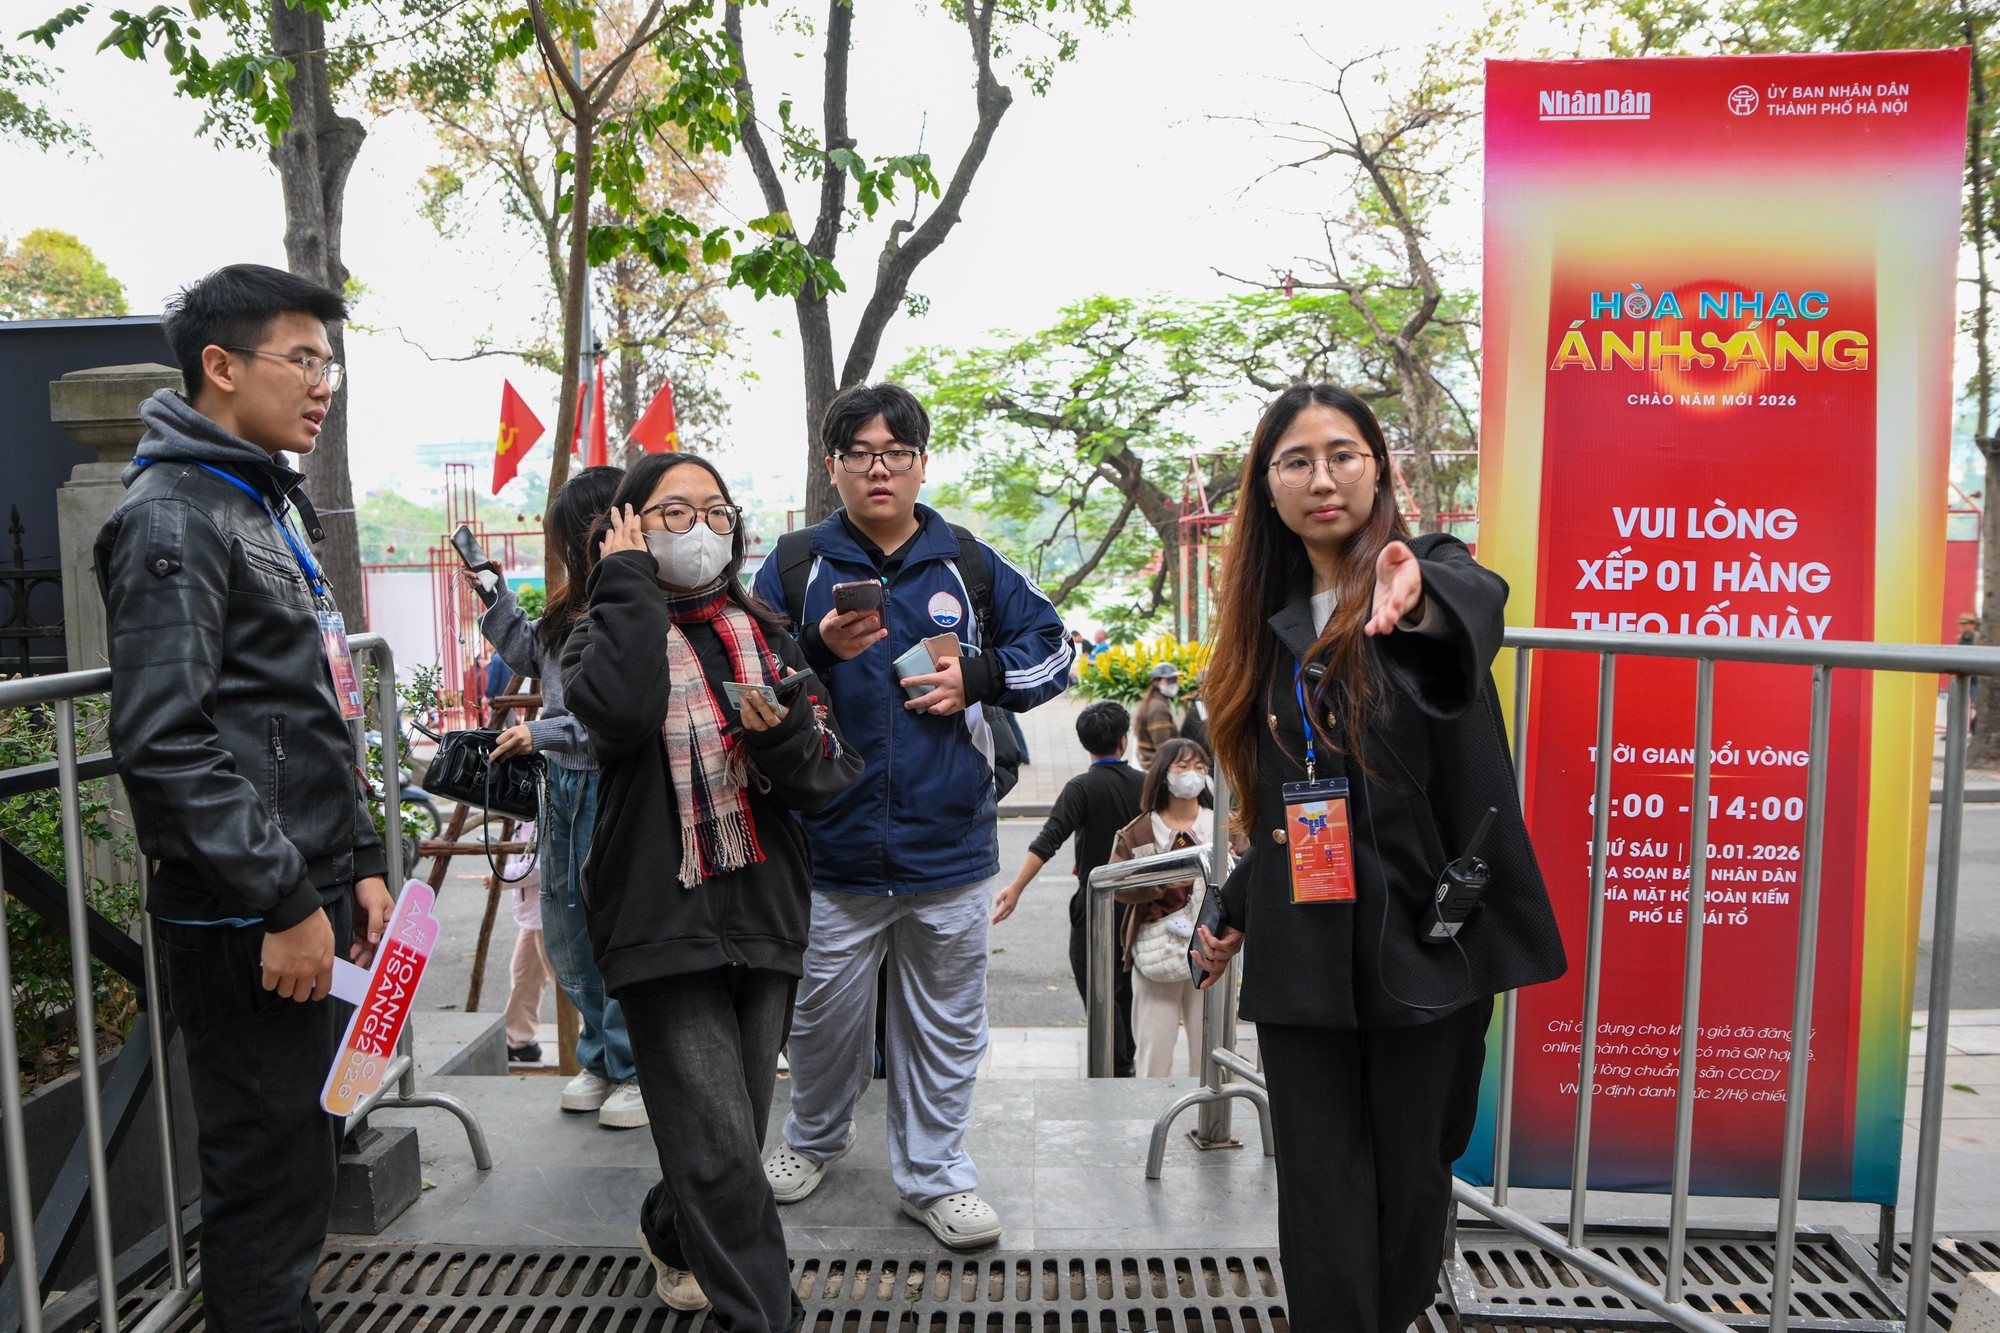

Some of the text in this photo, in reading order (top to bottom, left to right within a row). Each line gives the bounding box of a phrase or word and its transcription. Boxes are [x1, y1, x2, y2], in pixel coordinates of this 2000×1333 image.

[1767, 81, 1910, 99] ỦY BAN NHÂN DÂN
[1539, 88, 1651, 115] Nhân Dân
[1767, 98, 1908, 116] THÀNH PHỐ HÀ NỘI
[1699, 290, 1830, 326] NHẠC
[1627, 391, 1797, 407] CHÀO NĂM MỚI 2026
[1612, 498, 1799, 541] VUI LÒNG
[1575, 545, 1832, 594] XẾP 01 HÀNG
[1751, 605, 1833, 641] NÀY
[1588, 742, 1636, 764] TỜI
[1642, 748, 1695, 764] GIAN
[1746, 745, 1810, 766] VÒNG
[1708, 795, 1804, 821] 14:00
[1586, 837, 1626, 858] TỨ
[1629, 838, 1669, 858] SÁU
[1705, 844, 1801, 861] 0.01.2026
[1586, 865, 1797, 883] TA SOẠN BÁ NHÂN DÂN
[1603, 885, 1628, 901] HÍA
[1633, 886, 1666, 904] MẶT
[1752, 887, 1790, 905] KIẾM
[1629, 907, 1664, 923] PHỐ
[1667, 909, 1683, 924] LÊ
[1728, 906, 1749, 926] TỔ
[338, 899, 423, 1099] ANHSANG2026
[361, 929, 428, 1081] #HOANHAC
[1548, 1020, 1573, 1032] Chỉ
[1597, 1022, 1635, 1037] dụng
[1638, 1024, 1666, 1035] cho
[1707, 1024, 1731, 1039] giả
[1733, 1026, 1754, 1038] đã
[1757, 1027, 1794, 1041] đăng
[1542, 1042, 1582, 1053] online
[1631, 1044, 1669, 1059] công
[1696, 1045, 1713, 1058] có
[1716, 1047, 1741, 1059] mã
[1743, 1047, 1767, 1060] QR
[1600, 1063, 1631, 1078] lòng
[1634, 1063, 1680, 1077] chuẩn
[1727, 1067, 1782, 1081] CCCD/
[1605, 1084, 1635, 1098] định
[1638, 1085, 1676, 1098] danh
